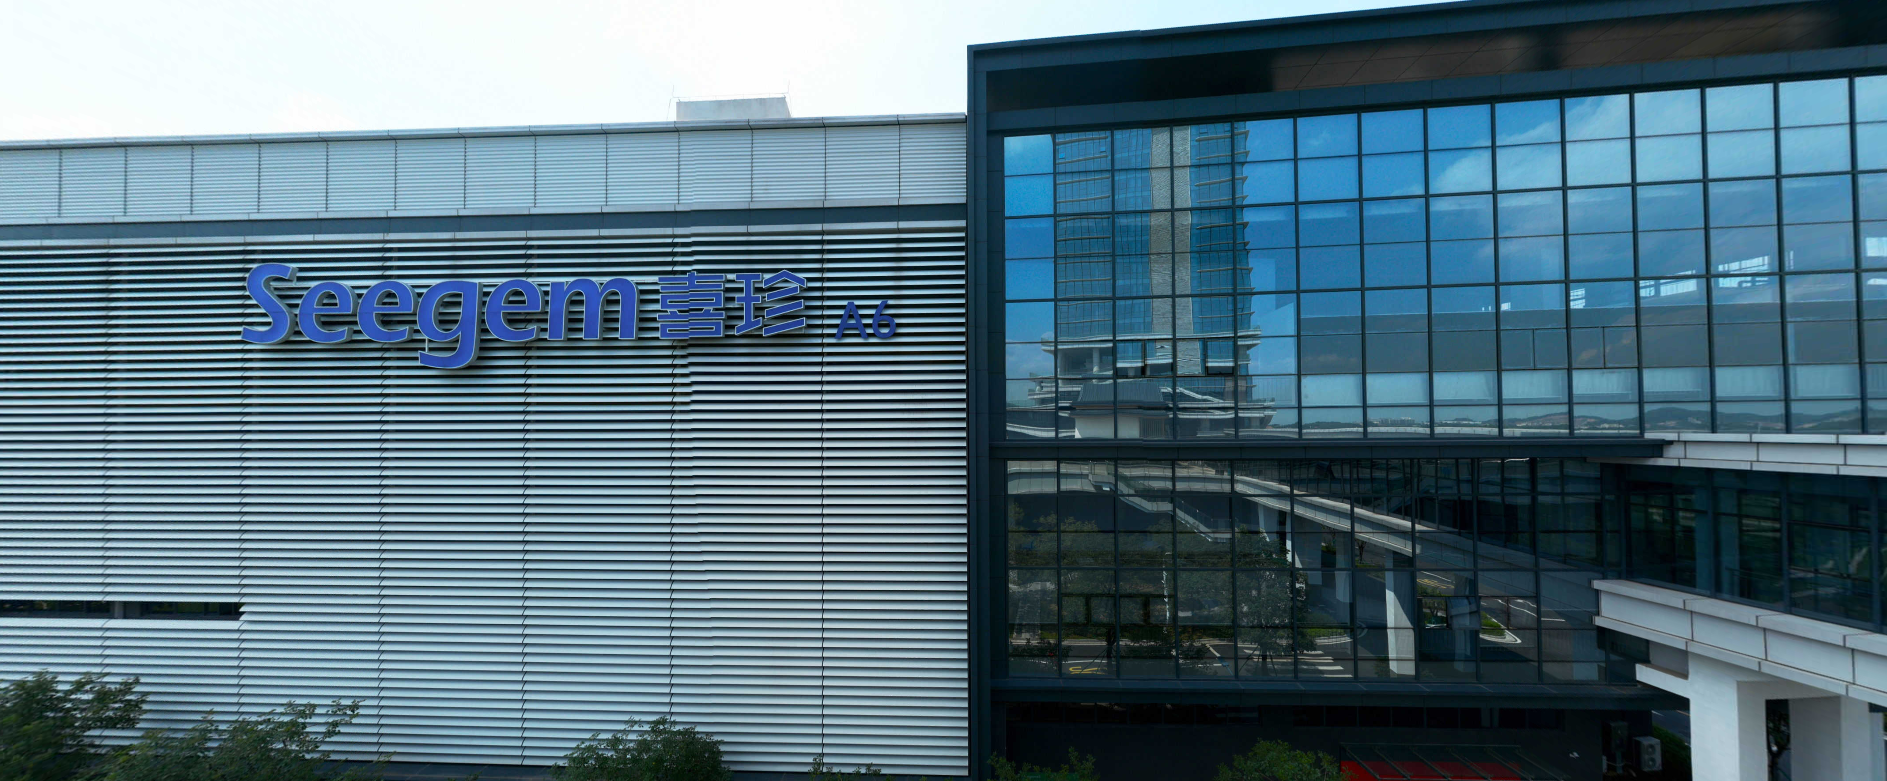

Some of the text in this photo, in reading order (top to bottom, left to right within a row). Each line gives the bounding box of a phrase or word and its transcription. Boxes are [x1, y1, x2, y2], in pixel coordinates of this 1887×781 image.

[241, 263, 897, 369] Seegem 喜珍 A6
